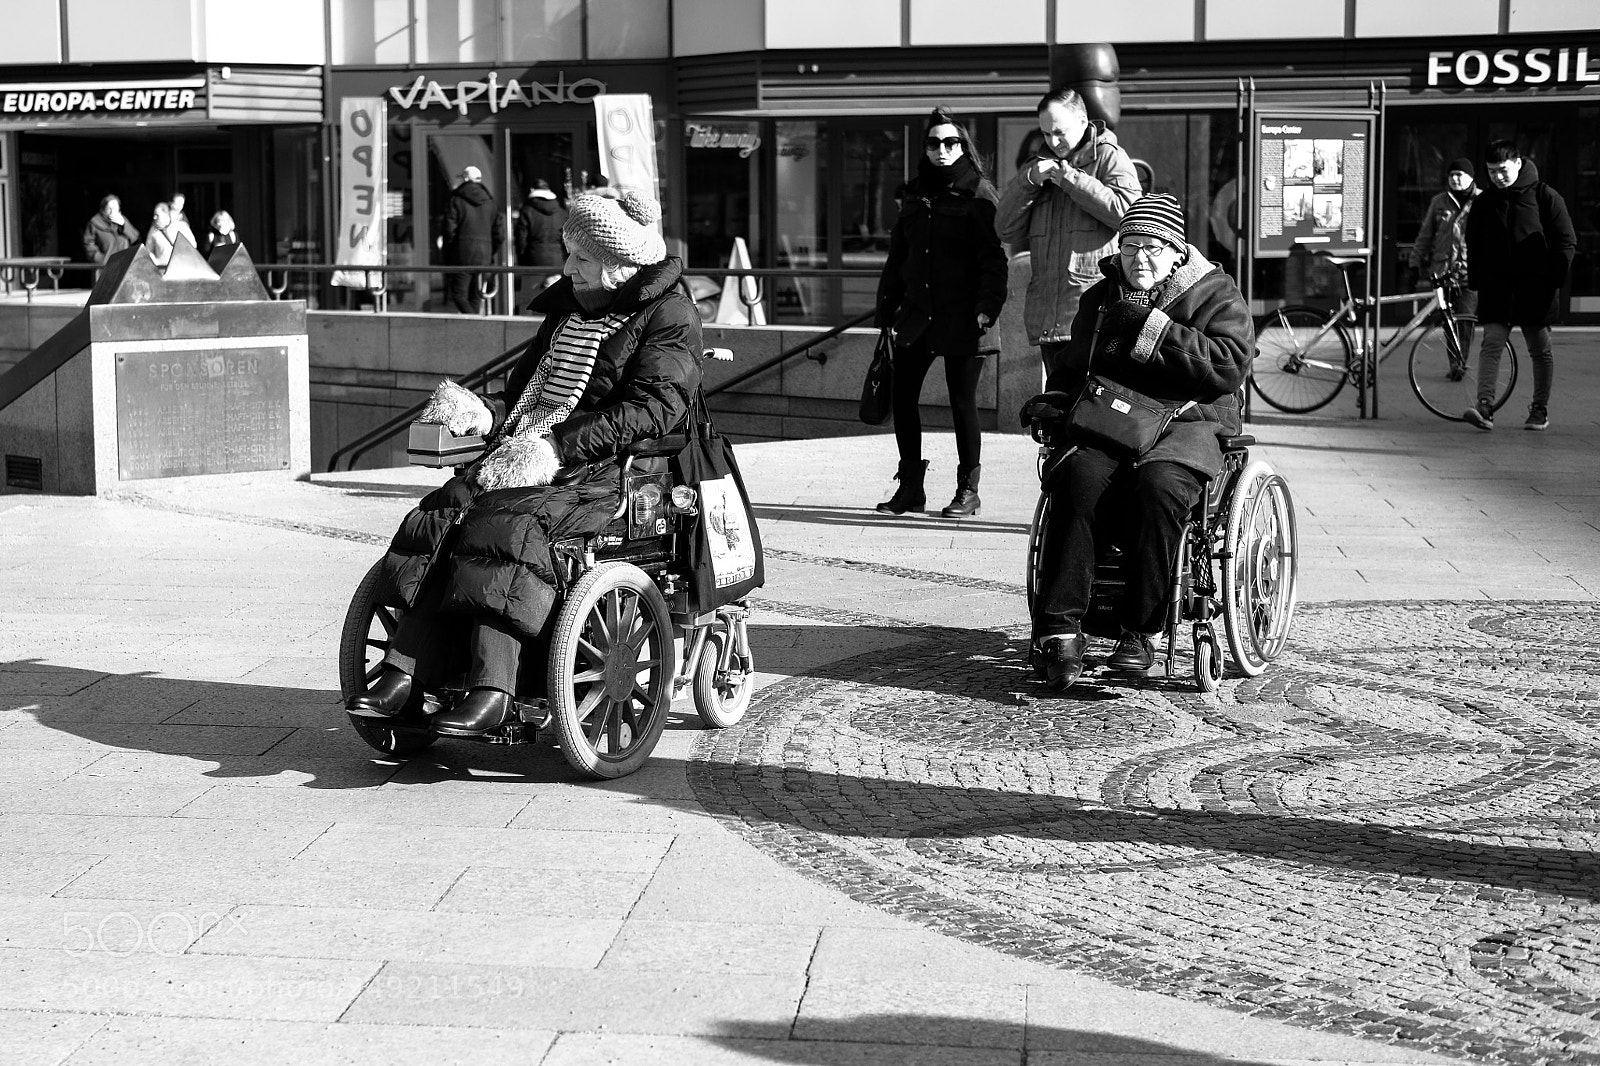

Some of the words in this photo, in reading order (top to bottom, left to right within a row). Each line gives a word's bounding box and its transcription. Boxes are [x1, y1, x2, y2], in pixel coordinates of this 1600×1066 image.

[1428, 48, 1600, 86] FOSSIL
[3, 89, 195, 113] EUROPA-CENTER
[389, 71, 606, 115] VAPIANO
[148, 360, 259, 377] SPONSOREN
